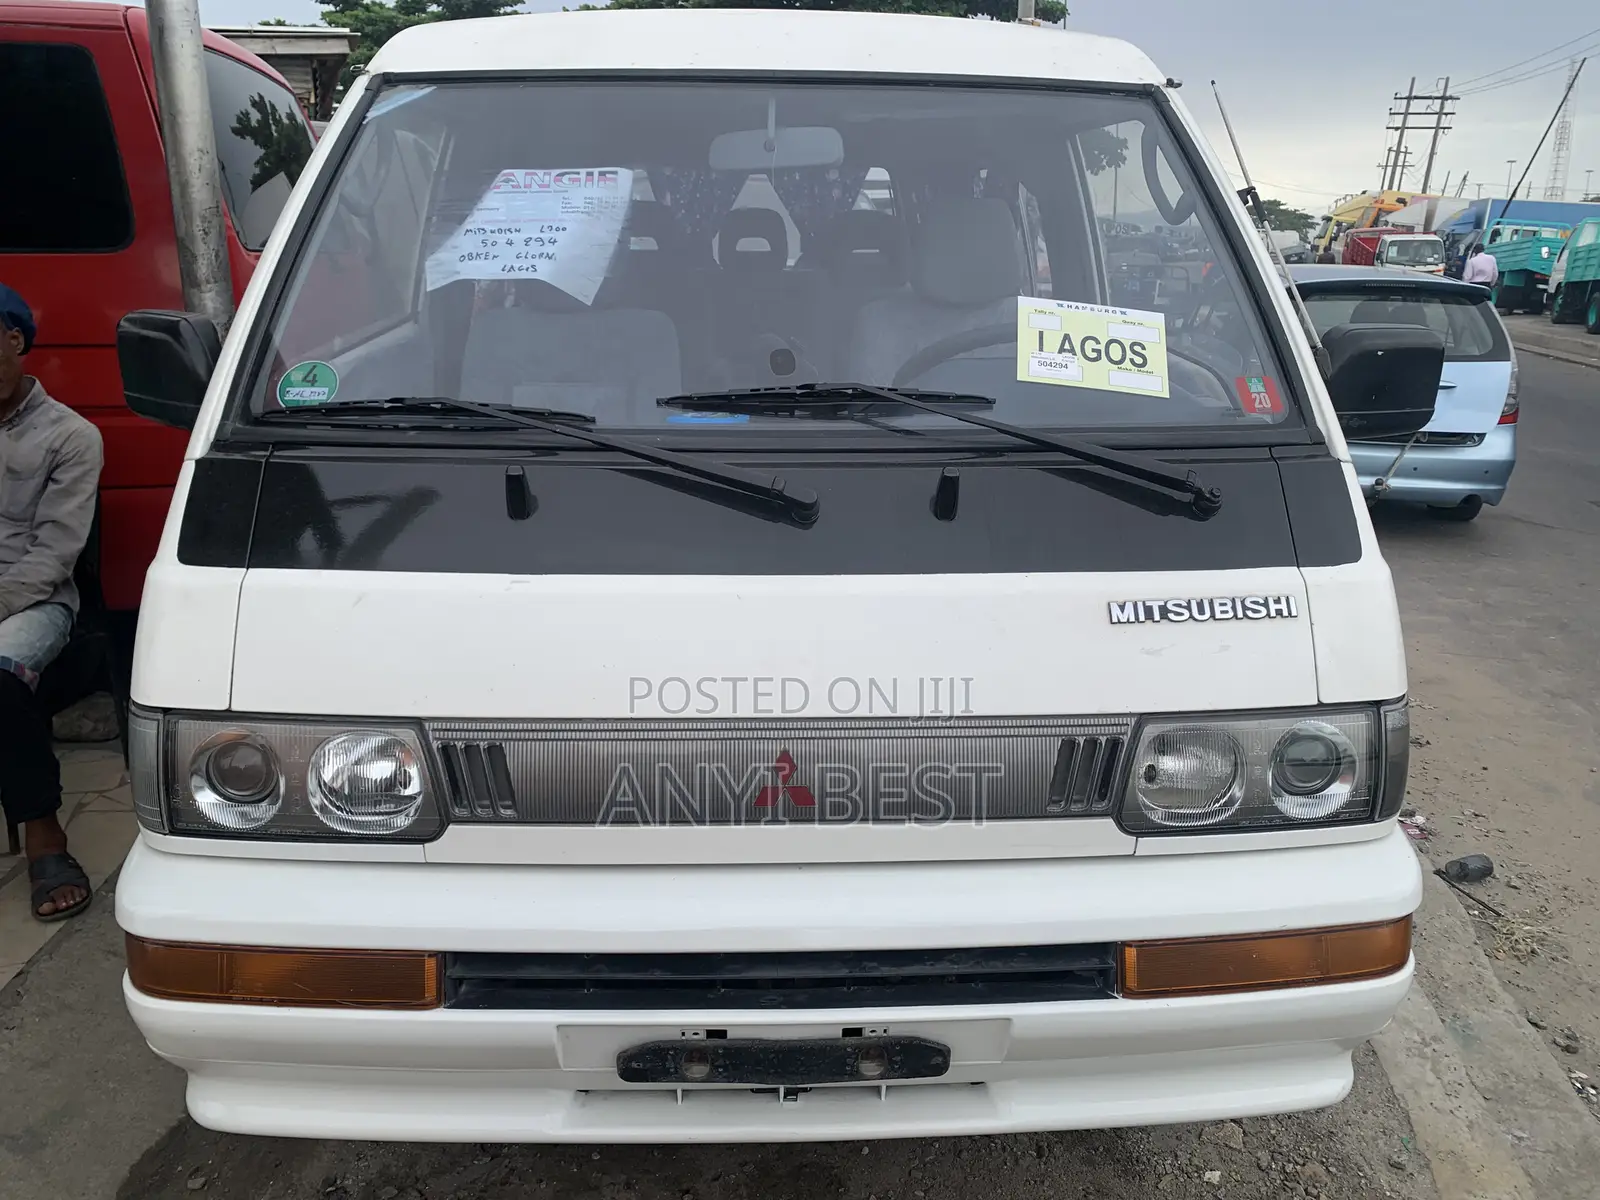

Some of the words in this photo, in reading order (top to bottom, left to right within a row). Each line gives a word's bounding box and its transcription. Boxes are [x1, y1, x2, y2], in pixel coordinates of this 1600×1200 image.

[1037, 360, 1069, 370] 504294
[301, 364, 318, 386] 4
[1252, 392, 1272, 409] 20
[1108, 595, 1299, 625] MITSUBISHI
